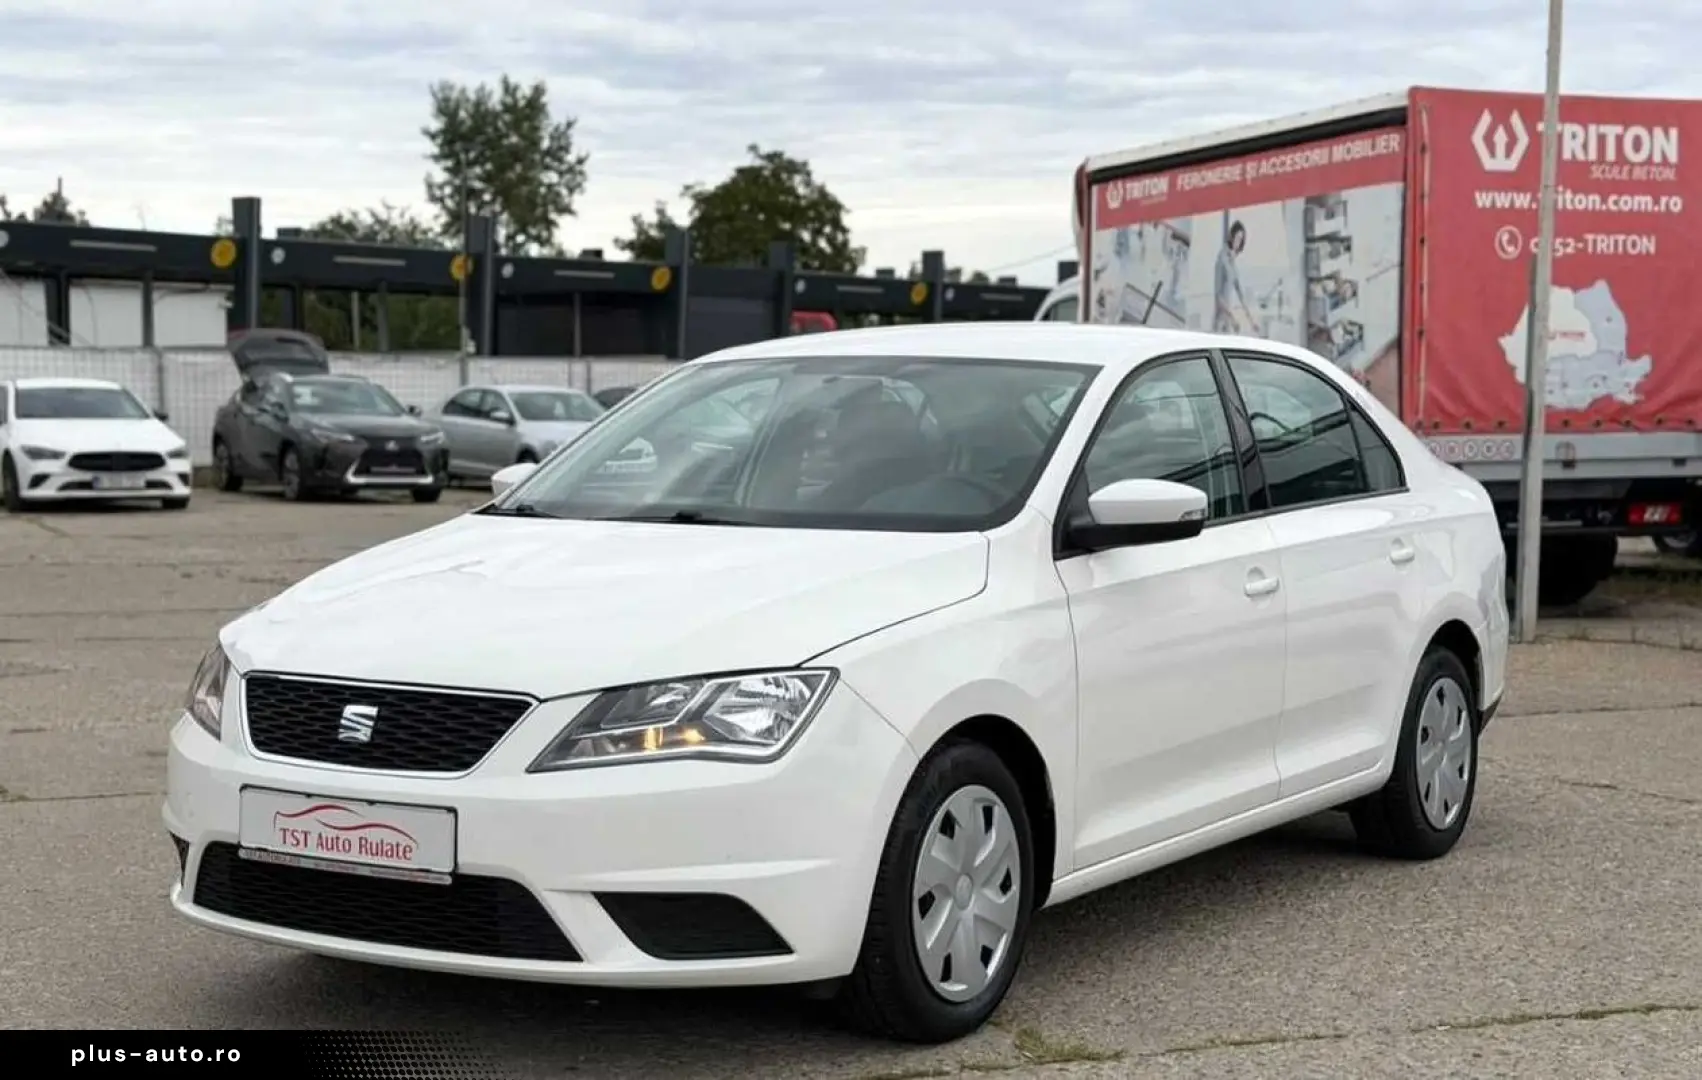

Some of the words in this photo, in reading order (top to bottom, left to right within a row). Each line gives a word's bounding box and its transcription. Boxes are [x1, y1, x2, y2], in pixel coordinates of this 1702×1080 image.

[1536, 122, 1679, 164] RITON
[1126, 176, 1169, 201] TRITON
[1331, 133, 1400, 163] MOBILIER
[1474, 186, 1682, 213] www.iton.com.ro
[280, 828, 311, 849] TST
[316, 831, 351, 854] Auto
[358, 835, 413, 862] Rulate
